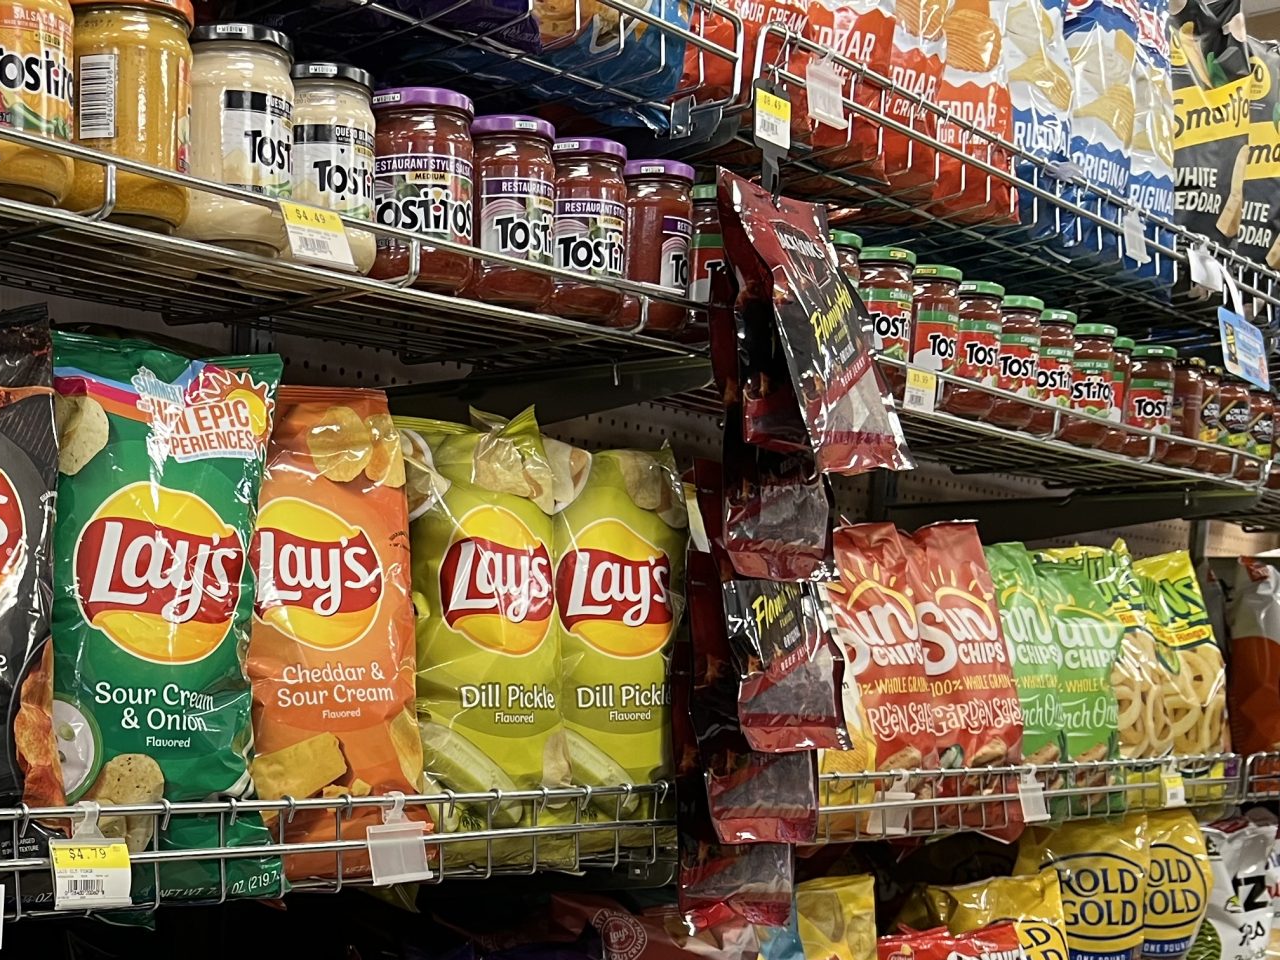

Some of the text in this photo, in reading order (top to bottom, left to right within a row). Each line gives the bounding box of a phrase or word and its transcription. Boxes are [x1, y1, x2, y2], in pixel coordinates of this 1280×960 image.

[770, 6, 809, 33] CREAM
[414, 172, 446, 182] MEDIUM
[430, 159, 454, 172] STYLE
[501, 181, 547, 197] RESTAURANT
[564, 202, 613, 215] RESTAURANT
[99, 521, 242, 623] Lay's
[257, 532, 371, 617] Lay's
[448, 540, 550, 623] Lay's
[566, 551, 667, 627] Lay's
[915, 600, 999, 676] Sun
[958, 642, 1006, 665] CHIPS
[282, 662, 385, 684] Cheddar &
[94, 681, 214, 710] Sour Cream
[276, 683, 394, 707] Sour Cream
[460, 684, 556, 709] Dill Pickle
[576, 685, 615, 708] Dill
[874, 677, 908, 695] WHOLE
[930, 674, 1011, 698] 100% WHOLE GRAIN
[121, 706, 207, 732] & Onion
[322, 707, 362, 721] Flavored
[494, 711, 534, 724] Flavored
[609, 710, 651, 721] Flavored
[146, 735, 191, 749] Flavored
[69, 848, 107, 860] $4.79
[1063, 900, 1138, 926] GOLD
